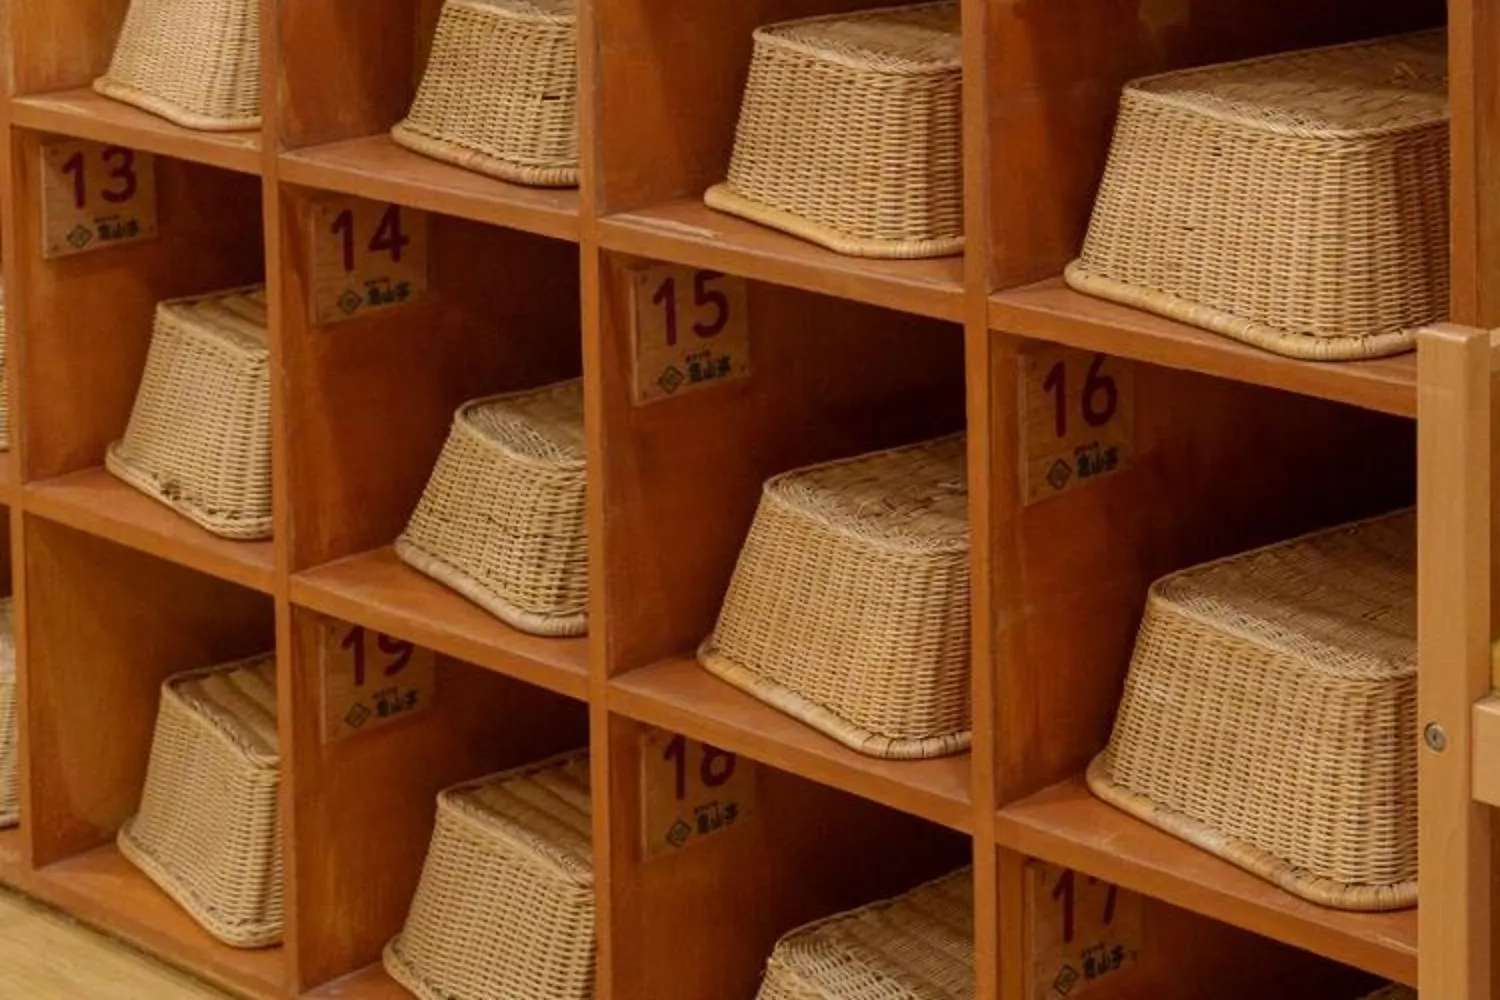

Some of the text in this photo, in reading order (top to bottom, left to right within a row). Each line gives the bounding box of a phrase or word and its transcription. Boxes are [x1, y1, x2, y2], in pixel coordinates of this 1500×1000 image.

[62, 145, 137, 209] 13
[332, 204, 411, 271] 14
[653, 269, 729, 346] 15
[1043, 352, 1118, 438] 16
